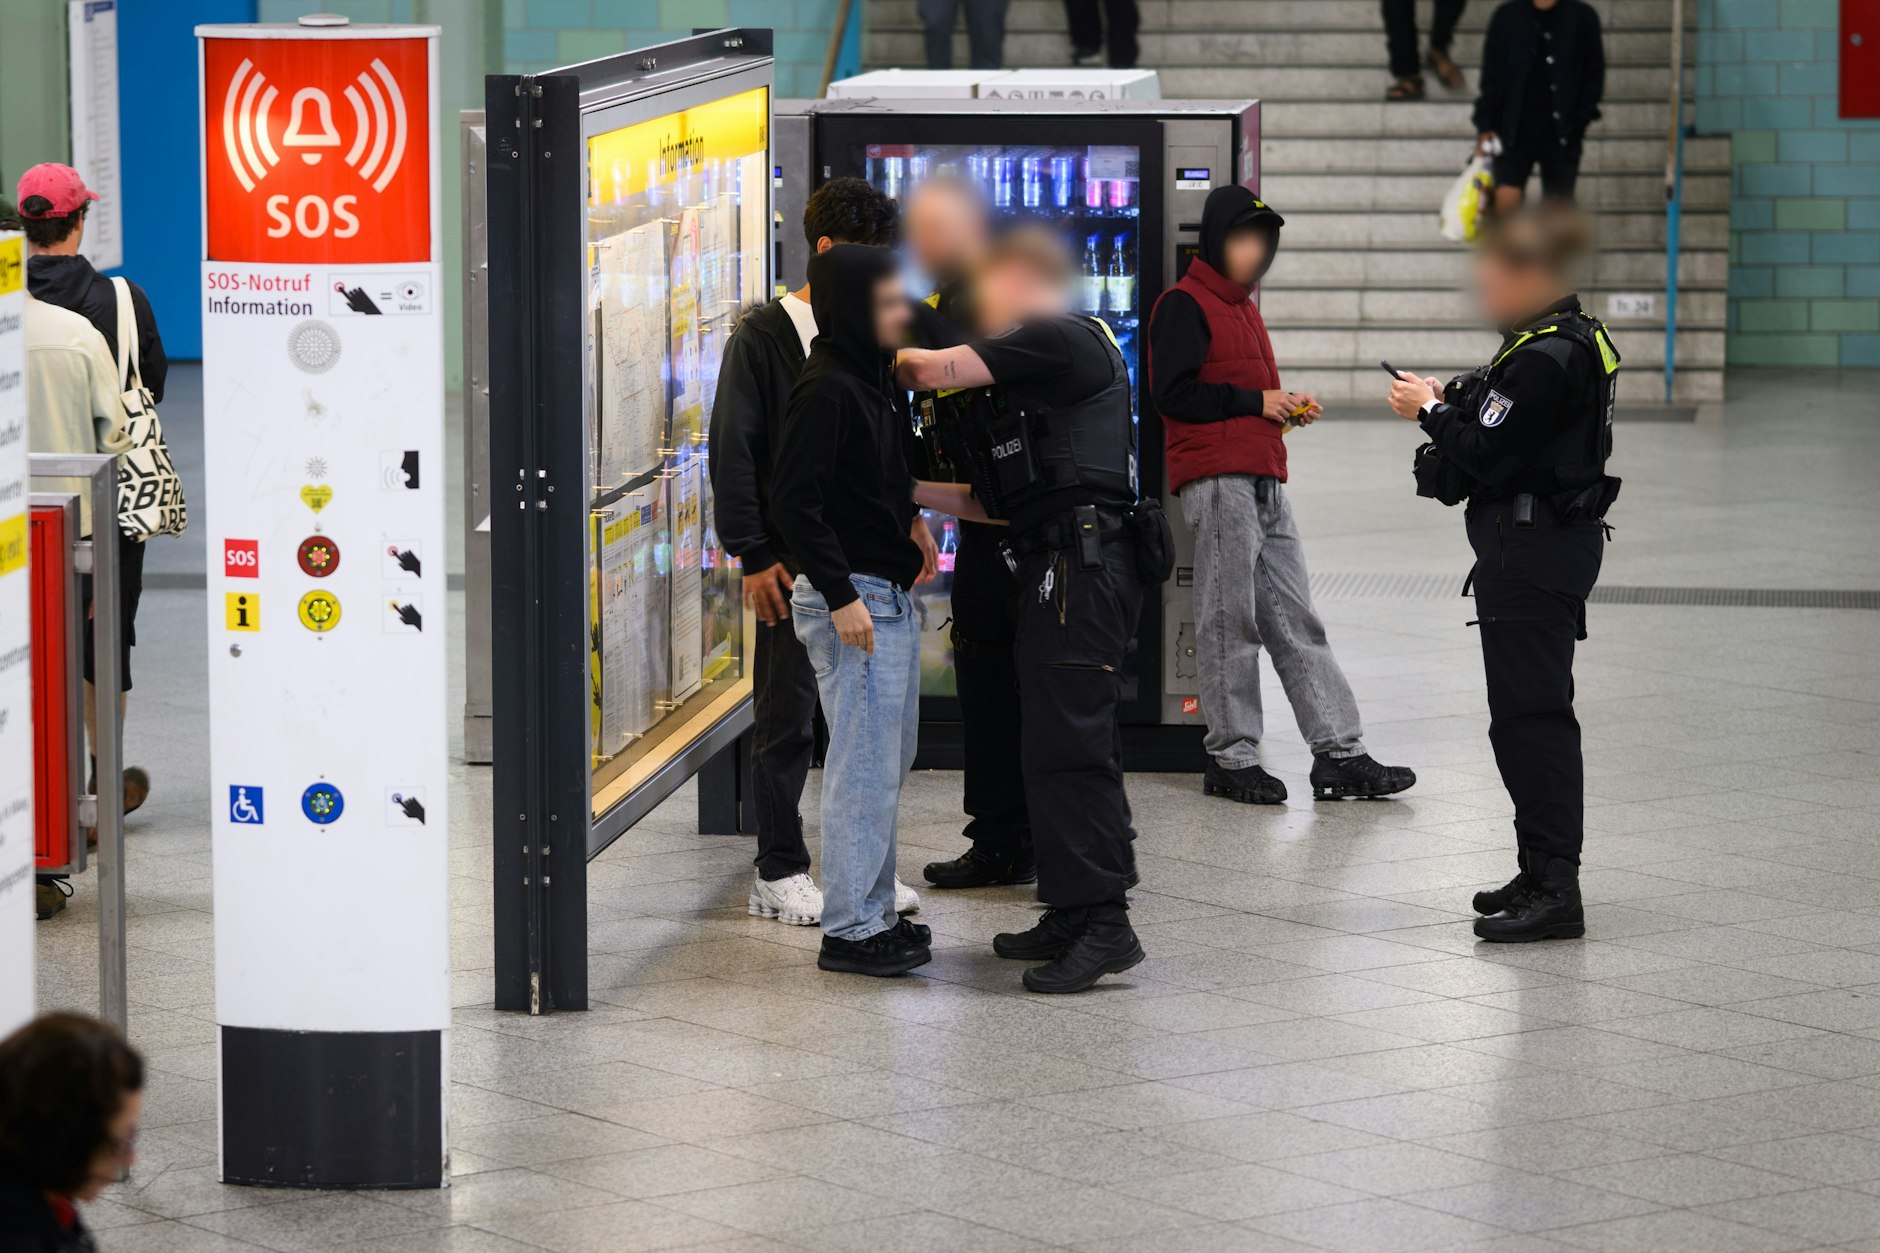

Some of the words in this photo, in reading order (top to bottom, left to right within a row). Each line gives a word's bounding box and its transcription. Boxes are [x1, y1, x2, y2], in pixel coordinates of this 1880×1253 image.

[659, 127, 705, 177] Information
[266, 195, 360, 238] SOS
[208, 272, 312, 292] SOS-Notruf
[208, 295, 313, 316] Information
[398, 303, 423, 312] Video
[1489, 392, 1511, 409] POLIZEI
[991, 437, 1023, 461] POLIZEI
[226, 549, 256, 567] SOS
